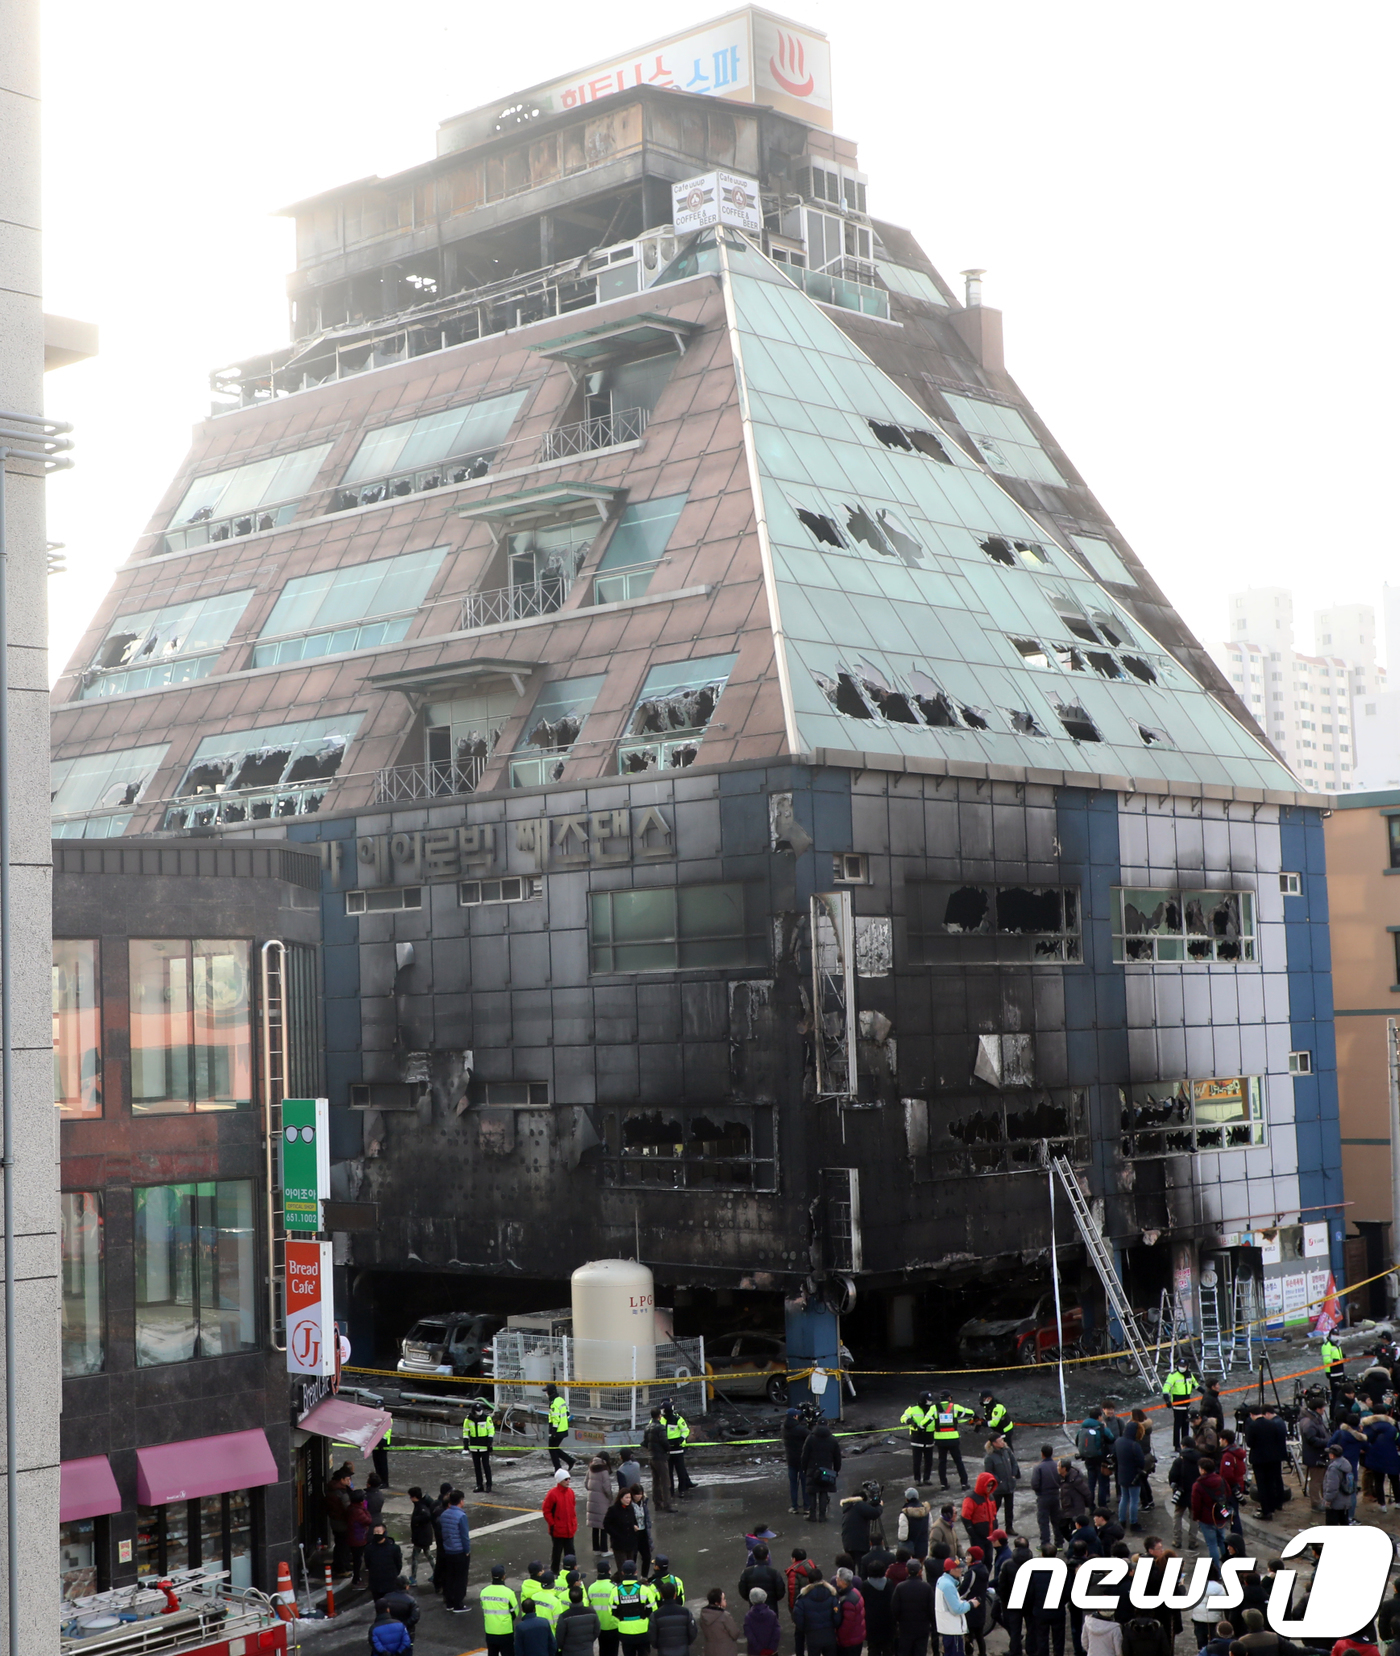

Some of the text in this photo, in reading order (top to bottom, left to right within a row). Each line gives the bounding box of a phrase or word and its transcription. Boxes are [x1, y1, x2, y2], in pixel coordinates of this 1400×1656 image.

[686, 45, 740, 94] 스파
[720, 172, 733, 184] Cafe
[674, 183, 689, 194] Cafe
[699, 214, 717, 226] BEER
[743, 219, 758, 230] BEER
[358, 823, 493, 884] 에어로빅
[285, 1188, 316, 1200] 아이조아
[286, 1213, 317, 1223] 651.1002
[289, 1260, 318, 1276] Bread
[629, 1294, 653, 1308] LPG
